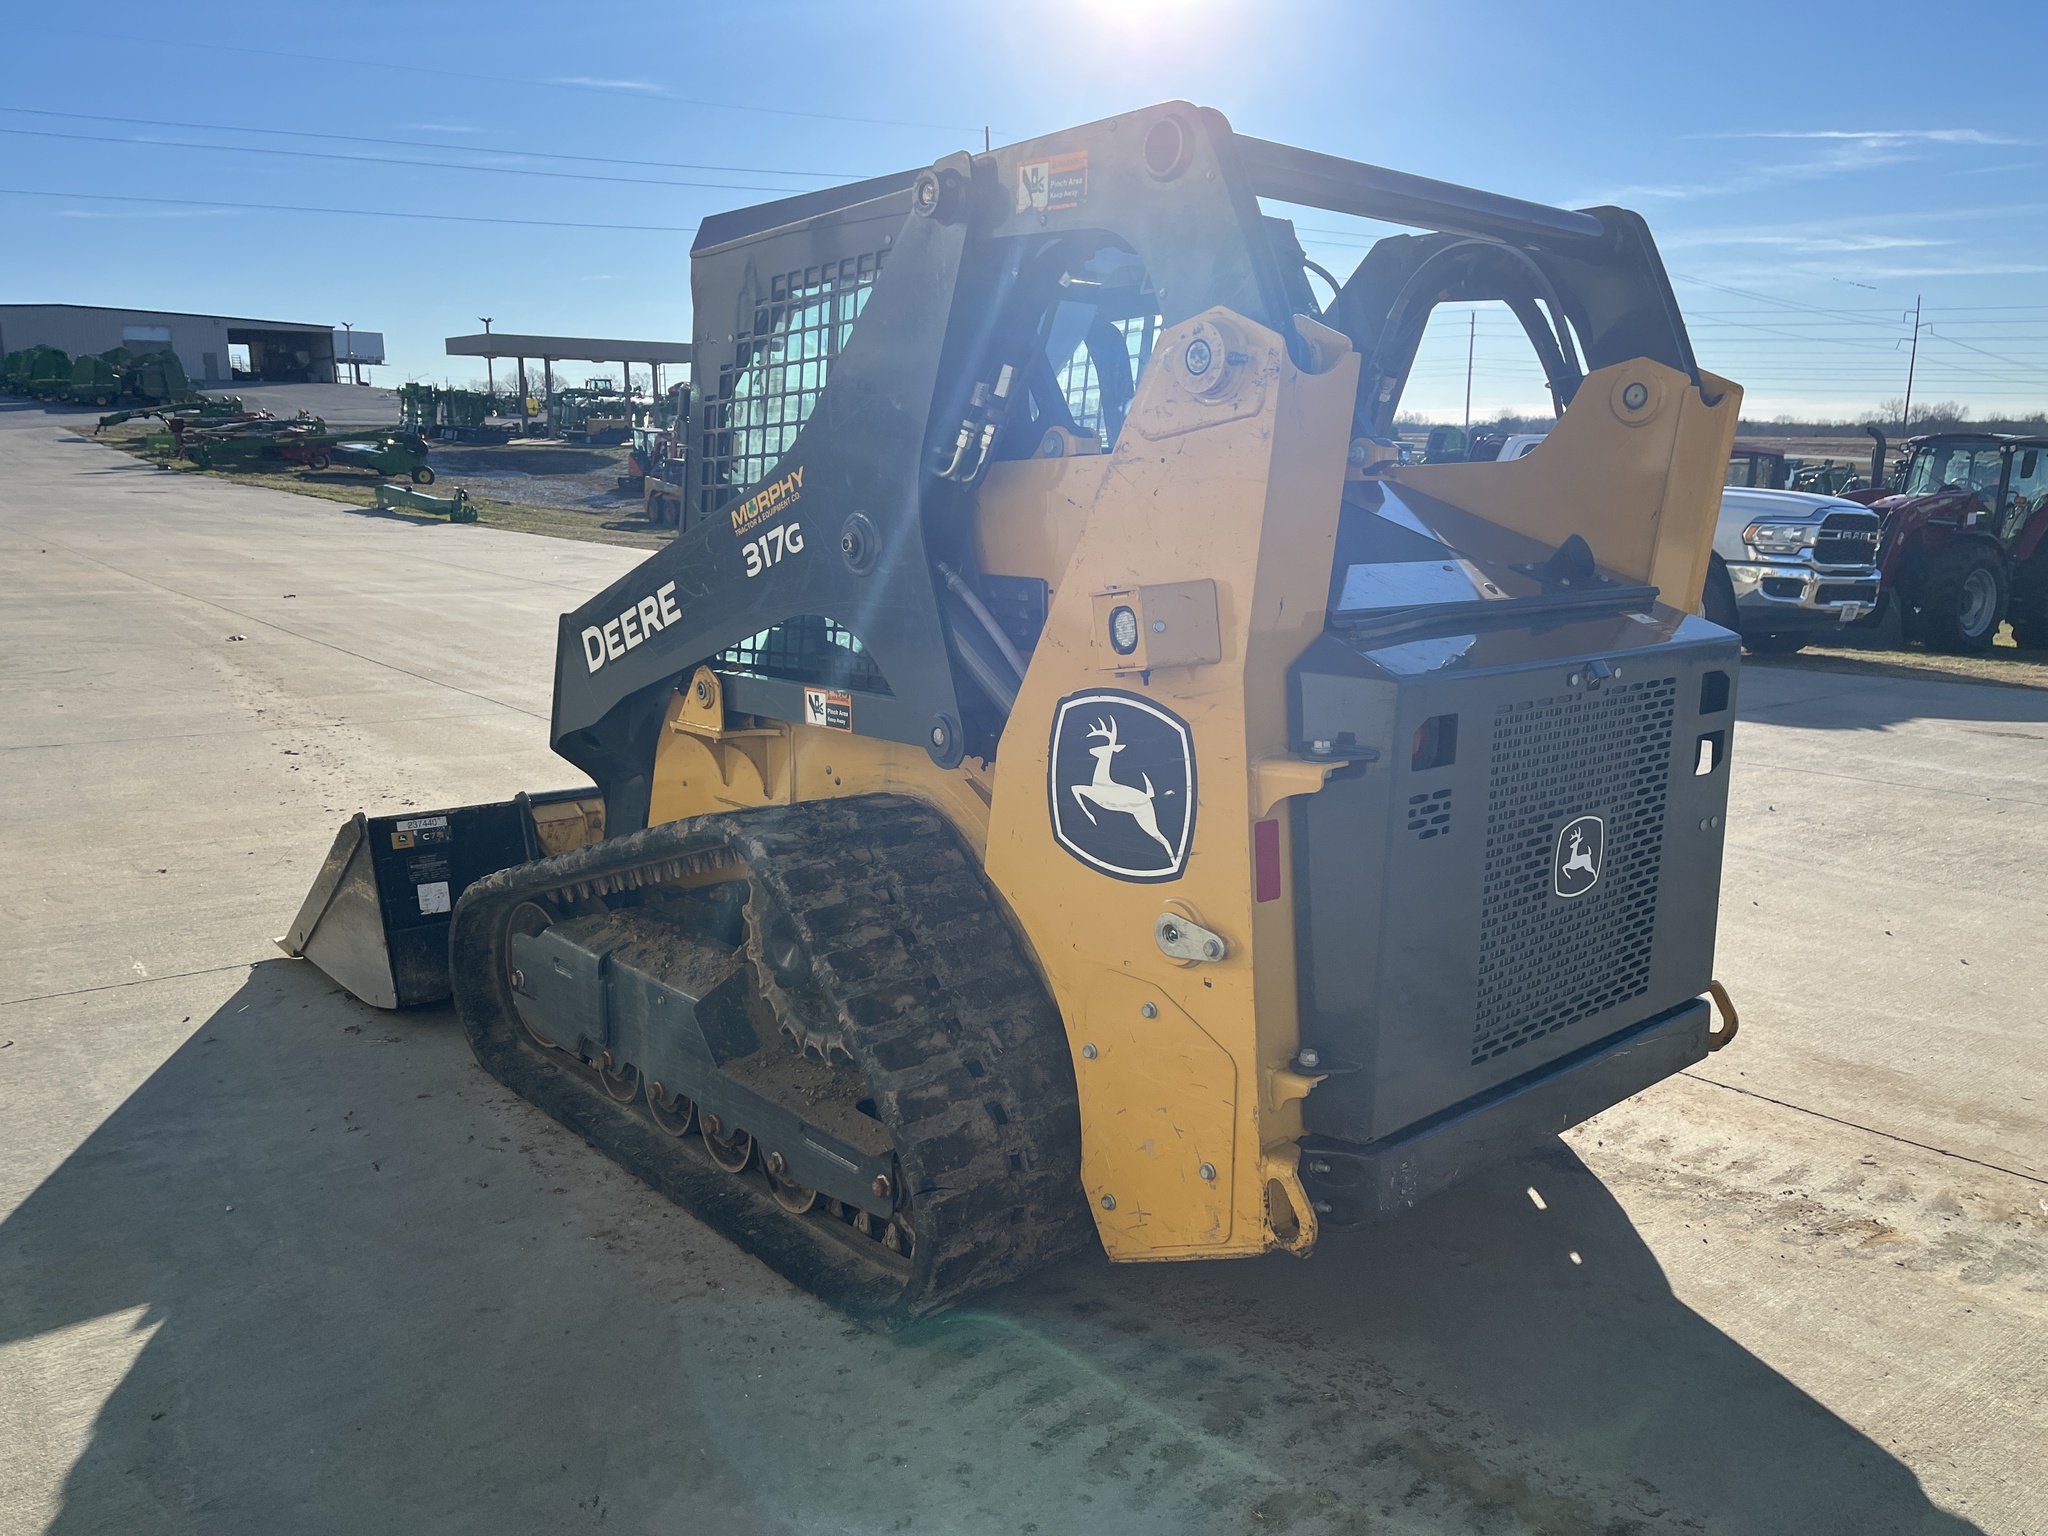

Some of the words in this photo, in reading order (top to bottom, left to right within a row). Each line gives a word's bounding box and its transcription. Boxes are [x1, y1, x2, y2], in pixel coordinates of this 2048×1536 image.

[1050, 179, 1067, 188] Pinch
[1069, 177, 1083, 186] Area
[731, 465, 804, 529] MURPHY
[734, 518, 758, 537] TRACTOR
[762, 496, 791, 521] EQUIPMENT
[790, 491, 802, 502] CO.
[742, 522, 804, 577] 317G
[581, 580, 683, 674] DEERE
[827, 707, 838, 715] Pinch
